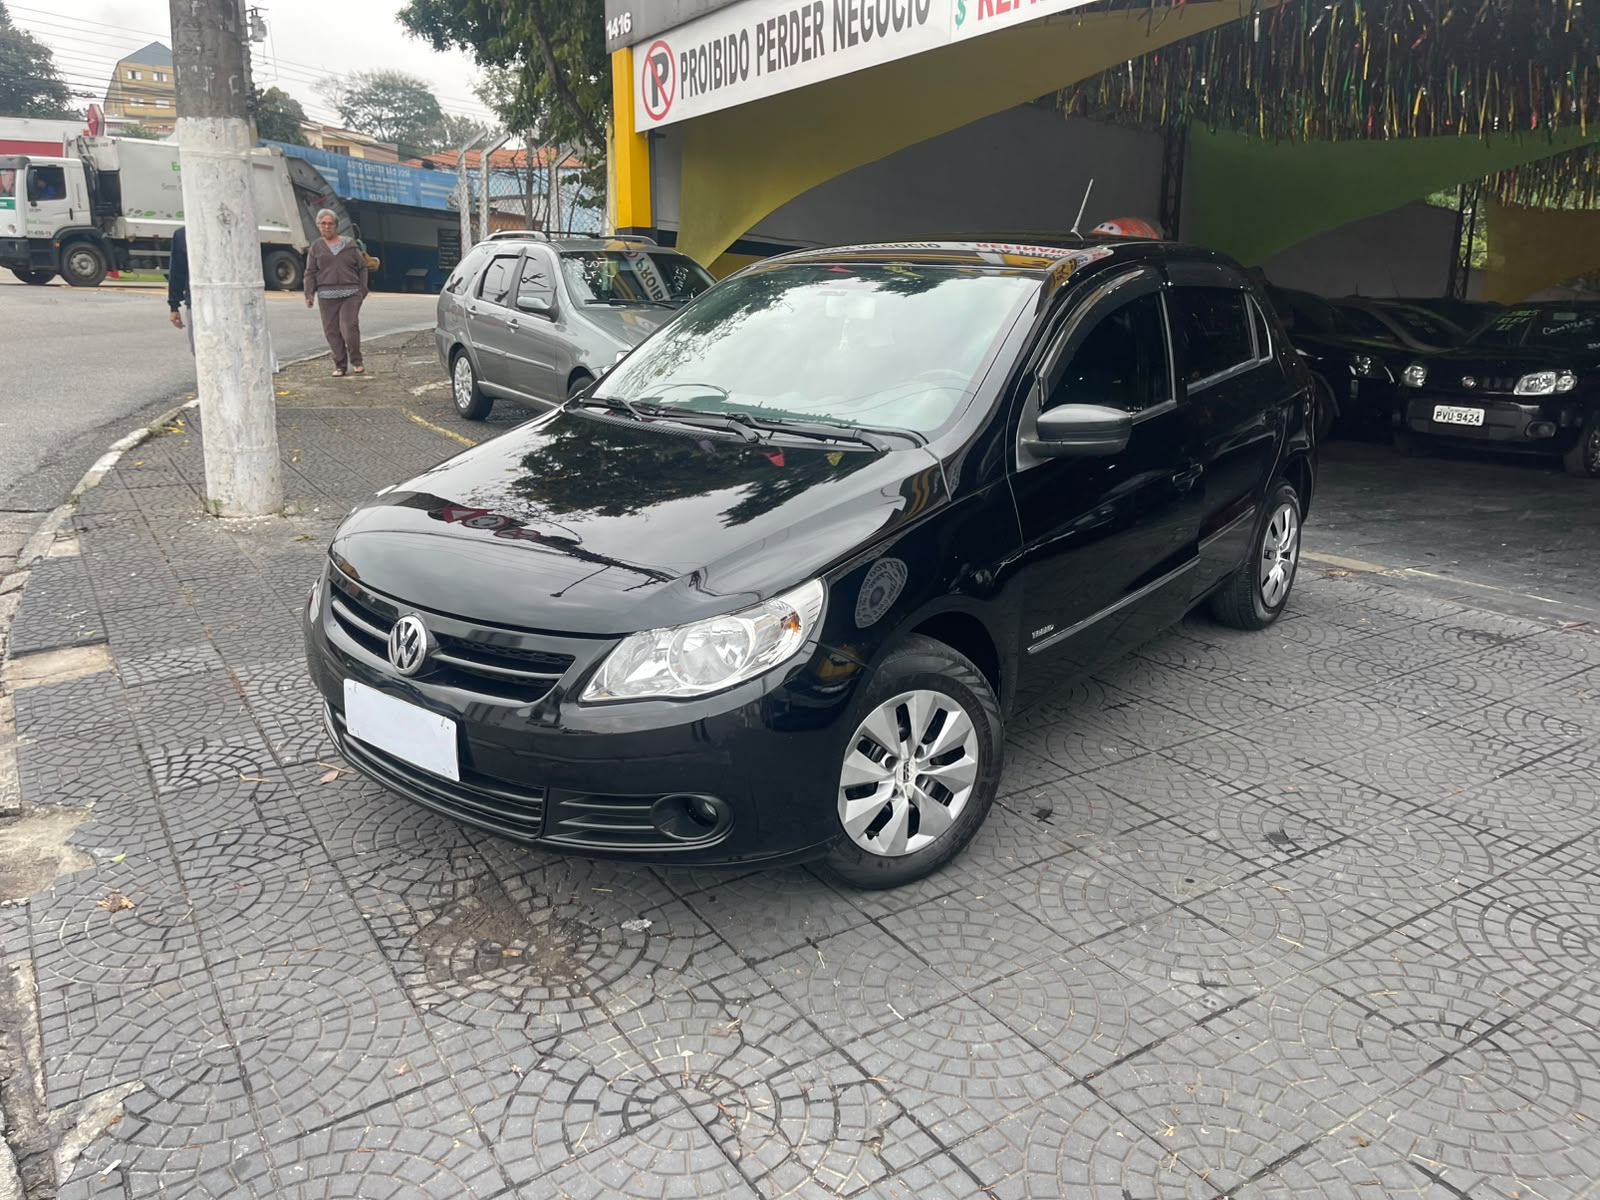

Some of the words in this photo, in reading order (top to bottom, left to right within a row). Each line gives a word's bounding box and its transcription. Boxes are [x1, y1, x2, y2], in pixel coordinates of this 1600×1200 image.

[606, 12, 632, 40] 1416
[680, 28, 750, 100] PROIBIDO
[756, 0, 825, 77] PERDER
